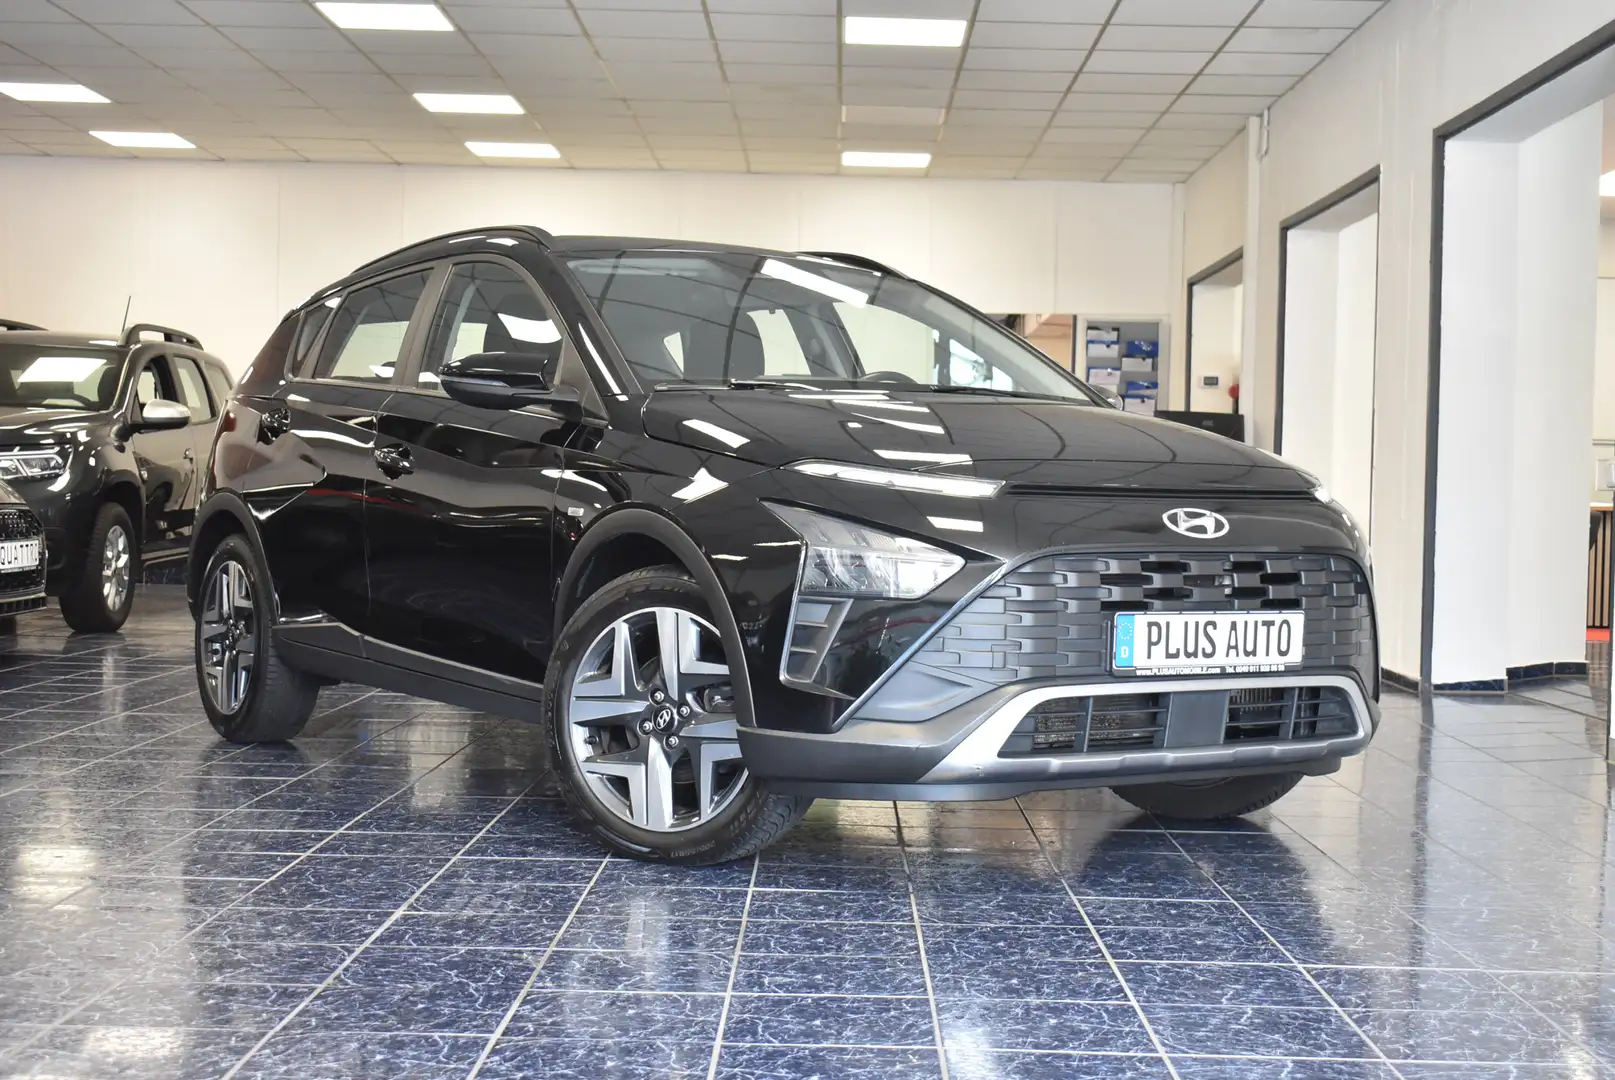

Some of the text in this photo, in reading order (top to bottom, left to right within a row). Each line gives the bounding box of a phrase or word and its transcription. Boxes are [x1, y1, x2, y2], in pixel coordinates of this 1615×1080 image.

[1, 543, 38, 566] QUATTRO
[1146, 619, 1292, 659] PLUS AUTO
[1120, 646, 1128, 658] D
